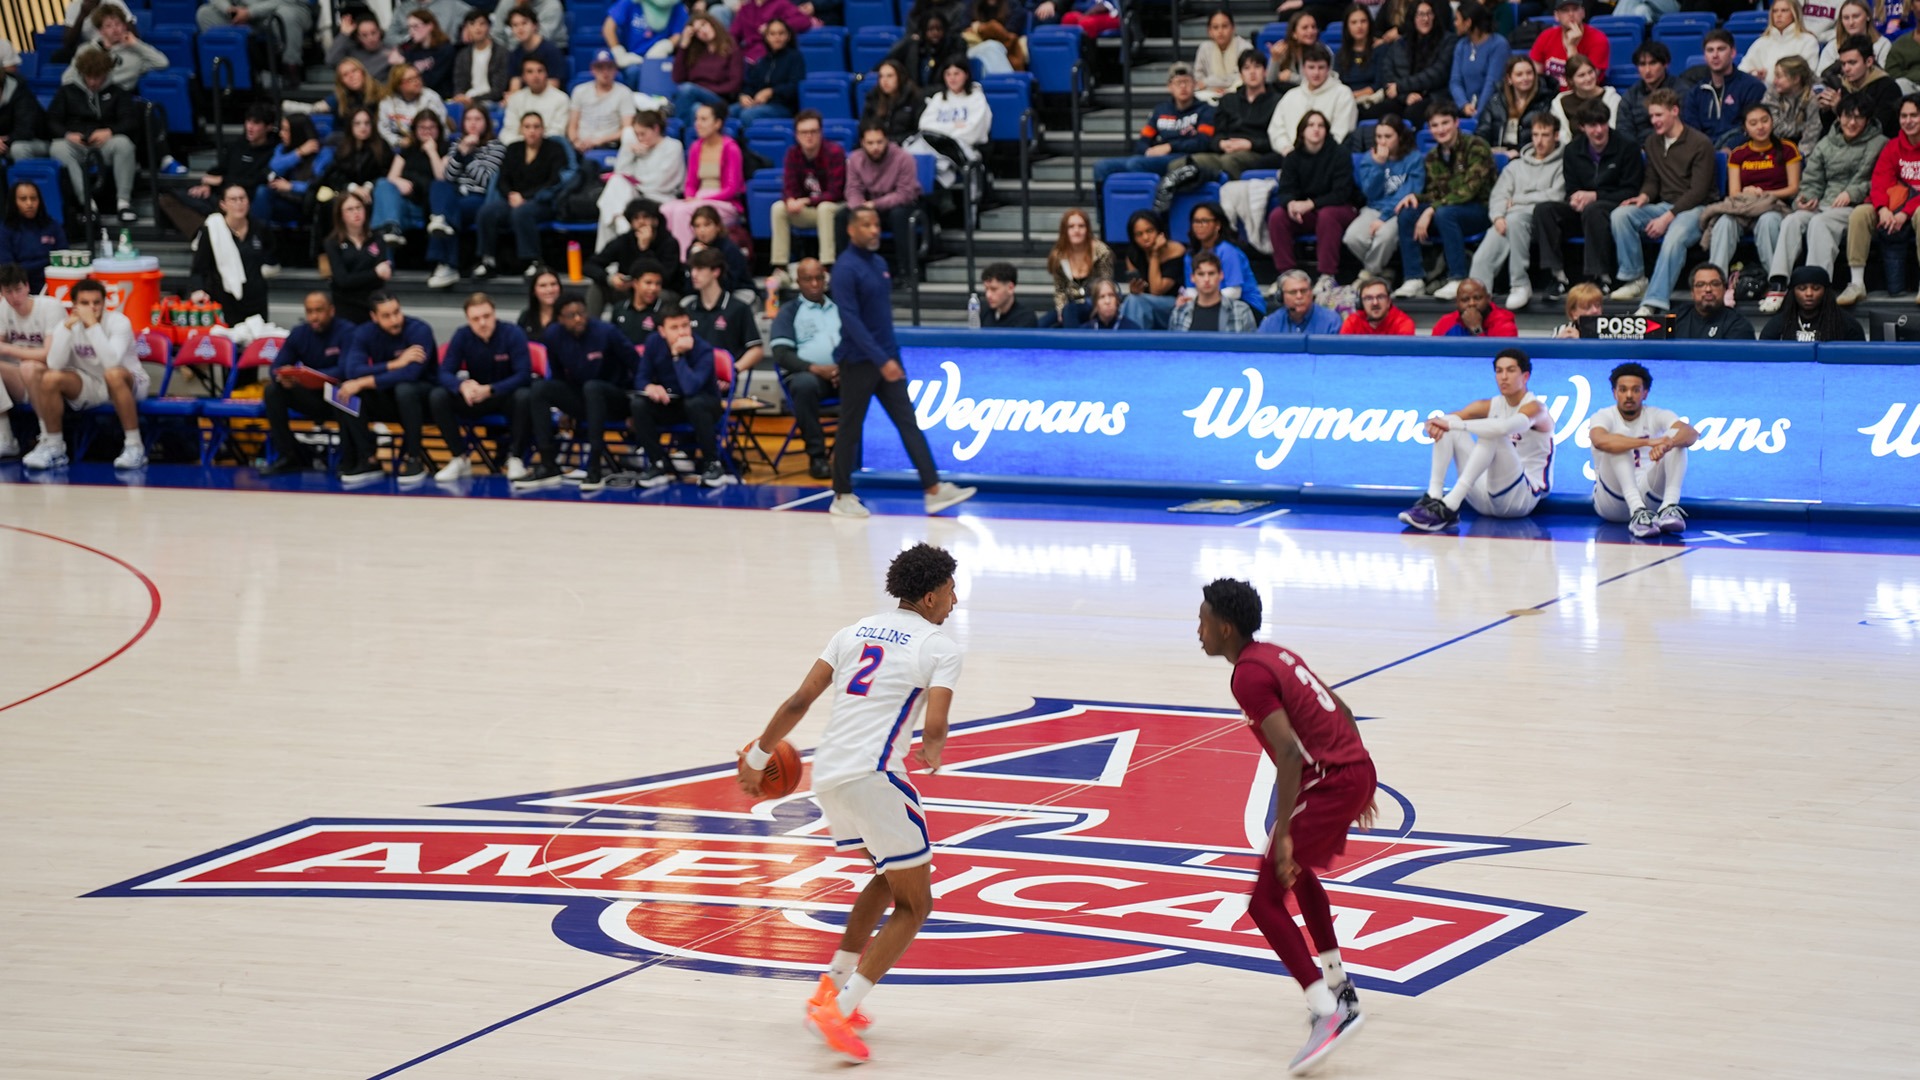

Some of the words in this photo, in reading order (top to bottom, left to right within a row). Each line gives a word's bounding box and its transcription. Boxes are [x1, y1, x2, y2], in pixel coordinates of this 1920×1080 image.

[1597, 317, 1647, 334] POSS
[907, 361, 1130, 461] Wegmans
[855, 626, 912, 645] COLLINS
[846, 643, 885, 697] 2
[1294, 665, 1336, 712] 3
[255, 840, 1457, 951] AMERICAN
